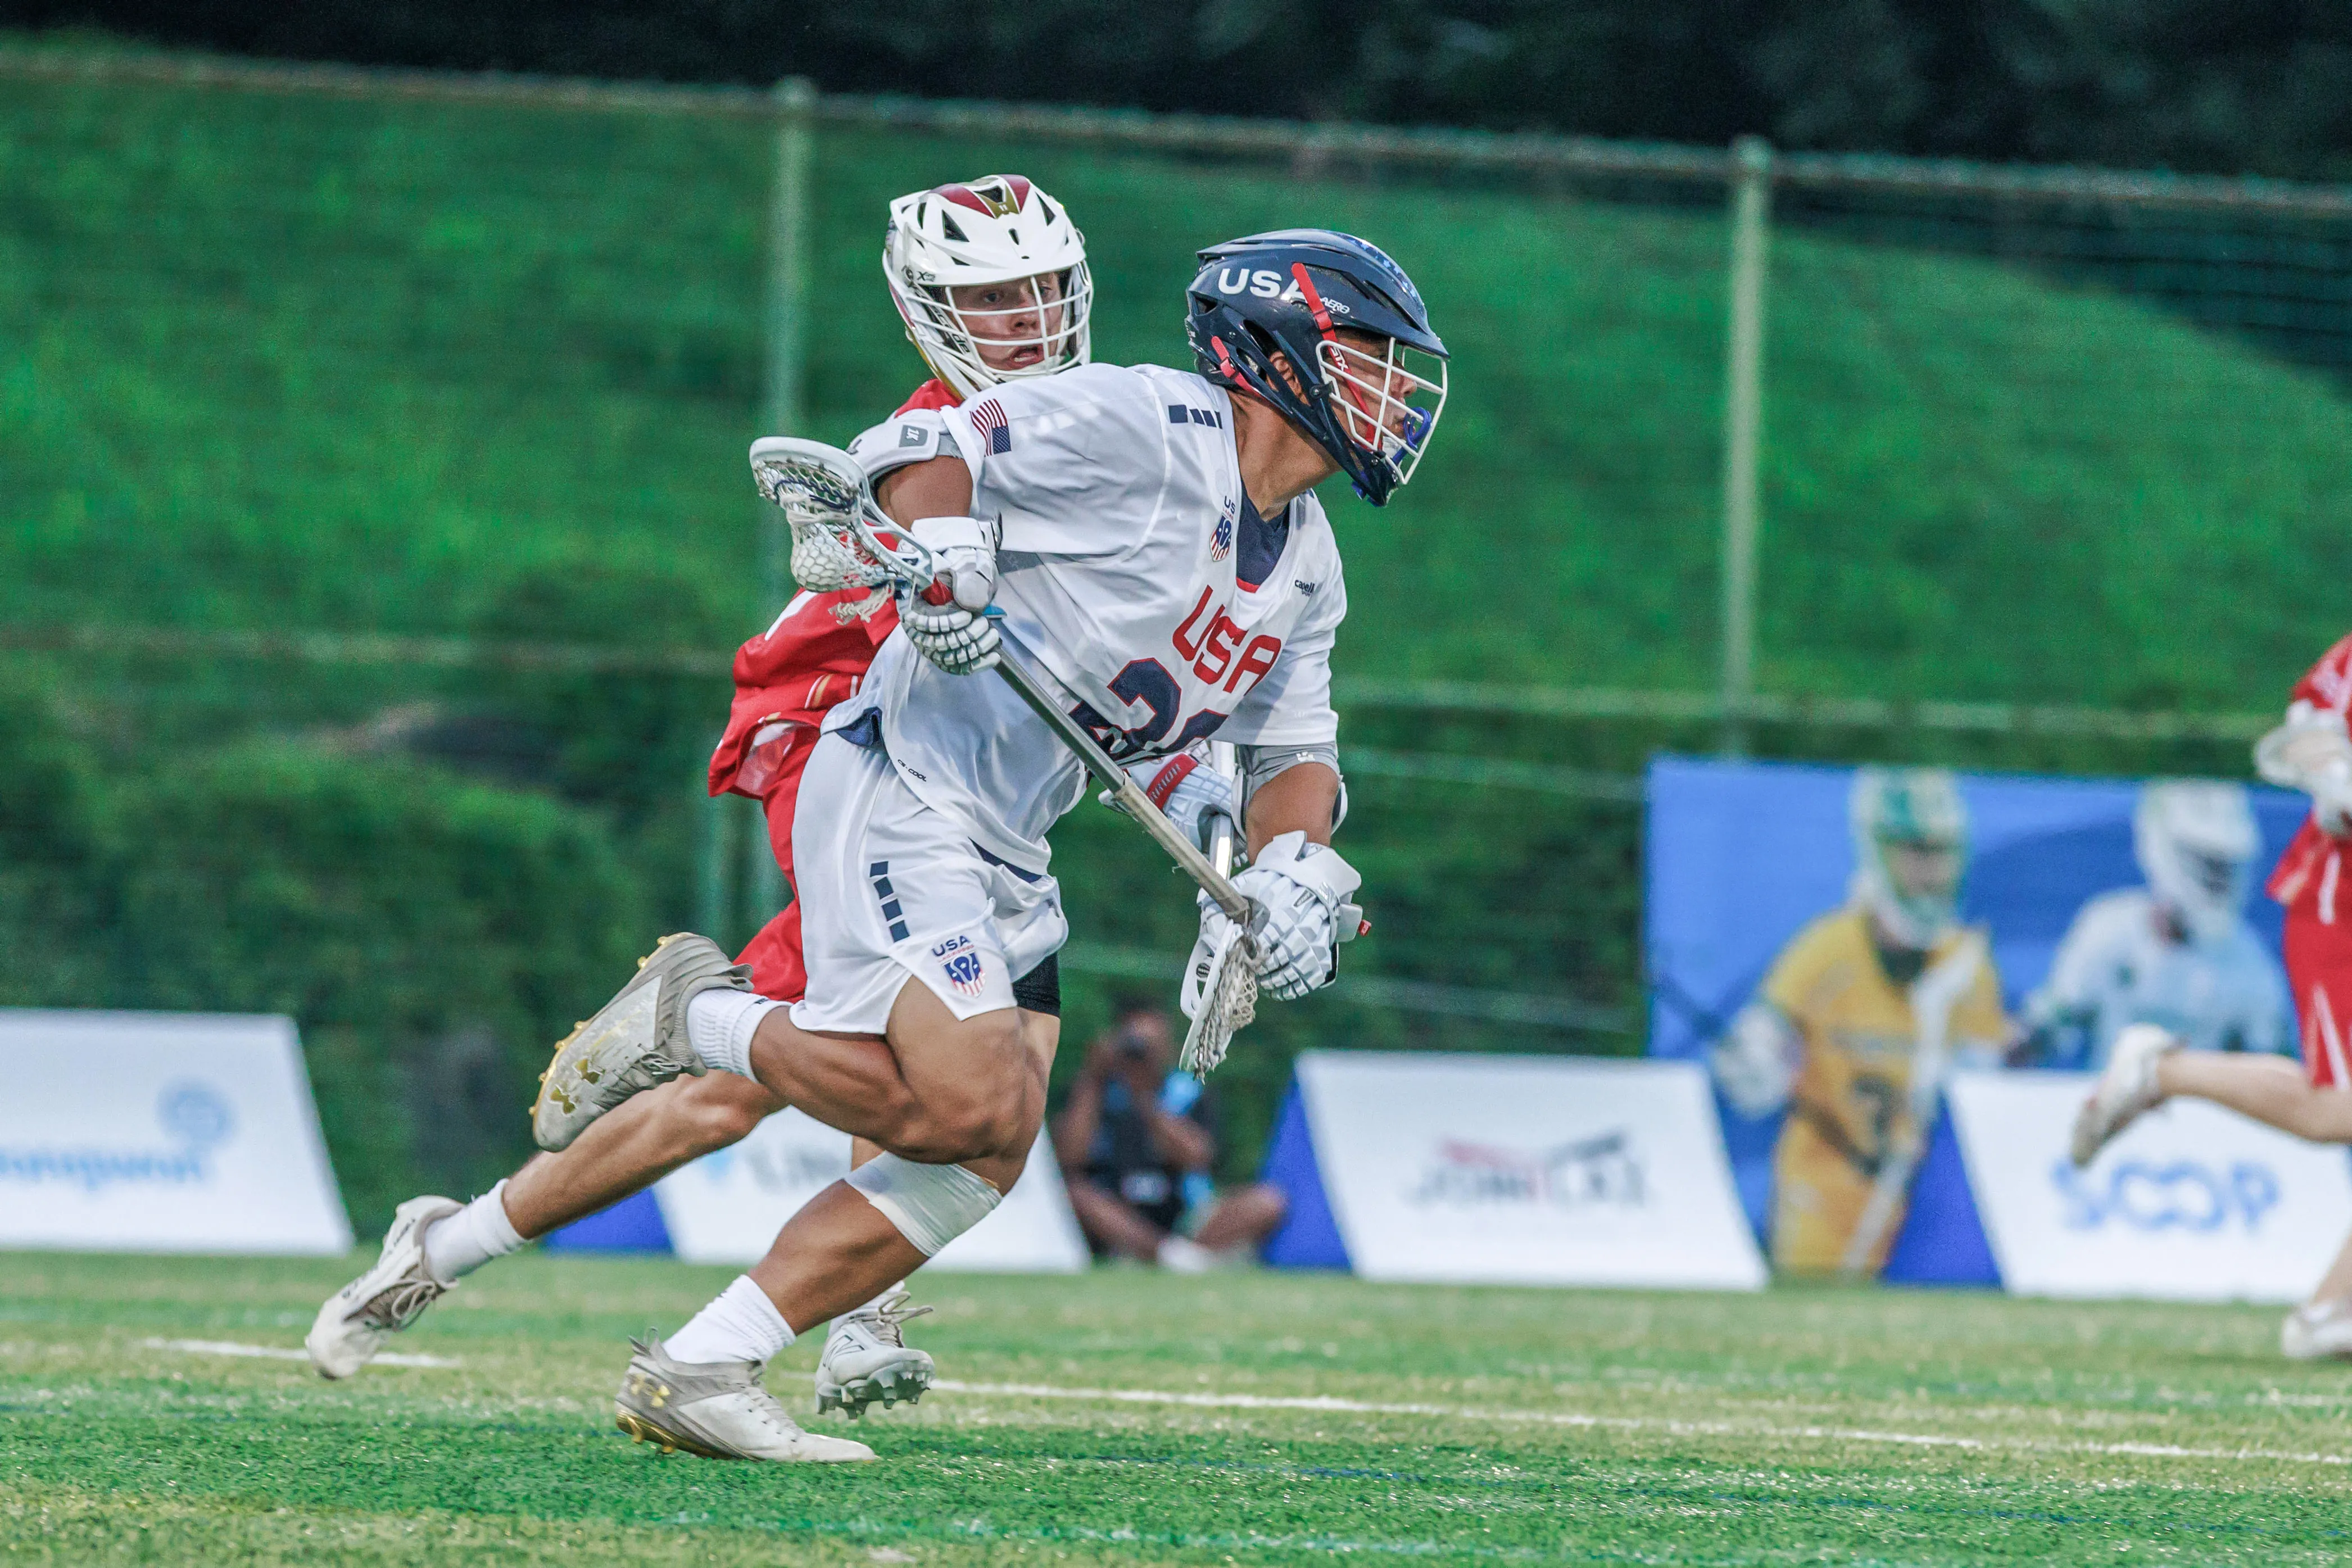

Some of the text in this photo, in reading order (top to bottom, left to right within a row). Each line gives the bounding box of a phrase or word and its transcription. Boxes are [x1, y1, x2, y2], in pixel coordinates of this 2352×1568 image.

[1218, 268, 1308, 303] USA
[1330, 346, 1349, 372] STX
[1224, 495, 1236, 515] US
[1172, 584, 1281, 696] USA
[931, 935, 971, 957] USA
